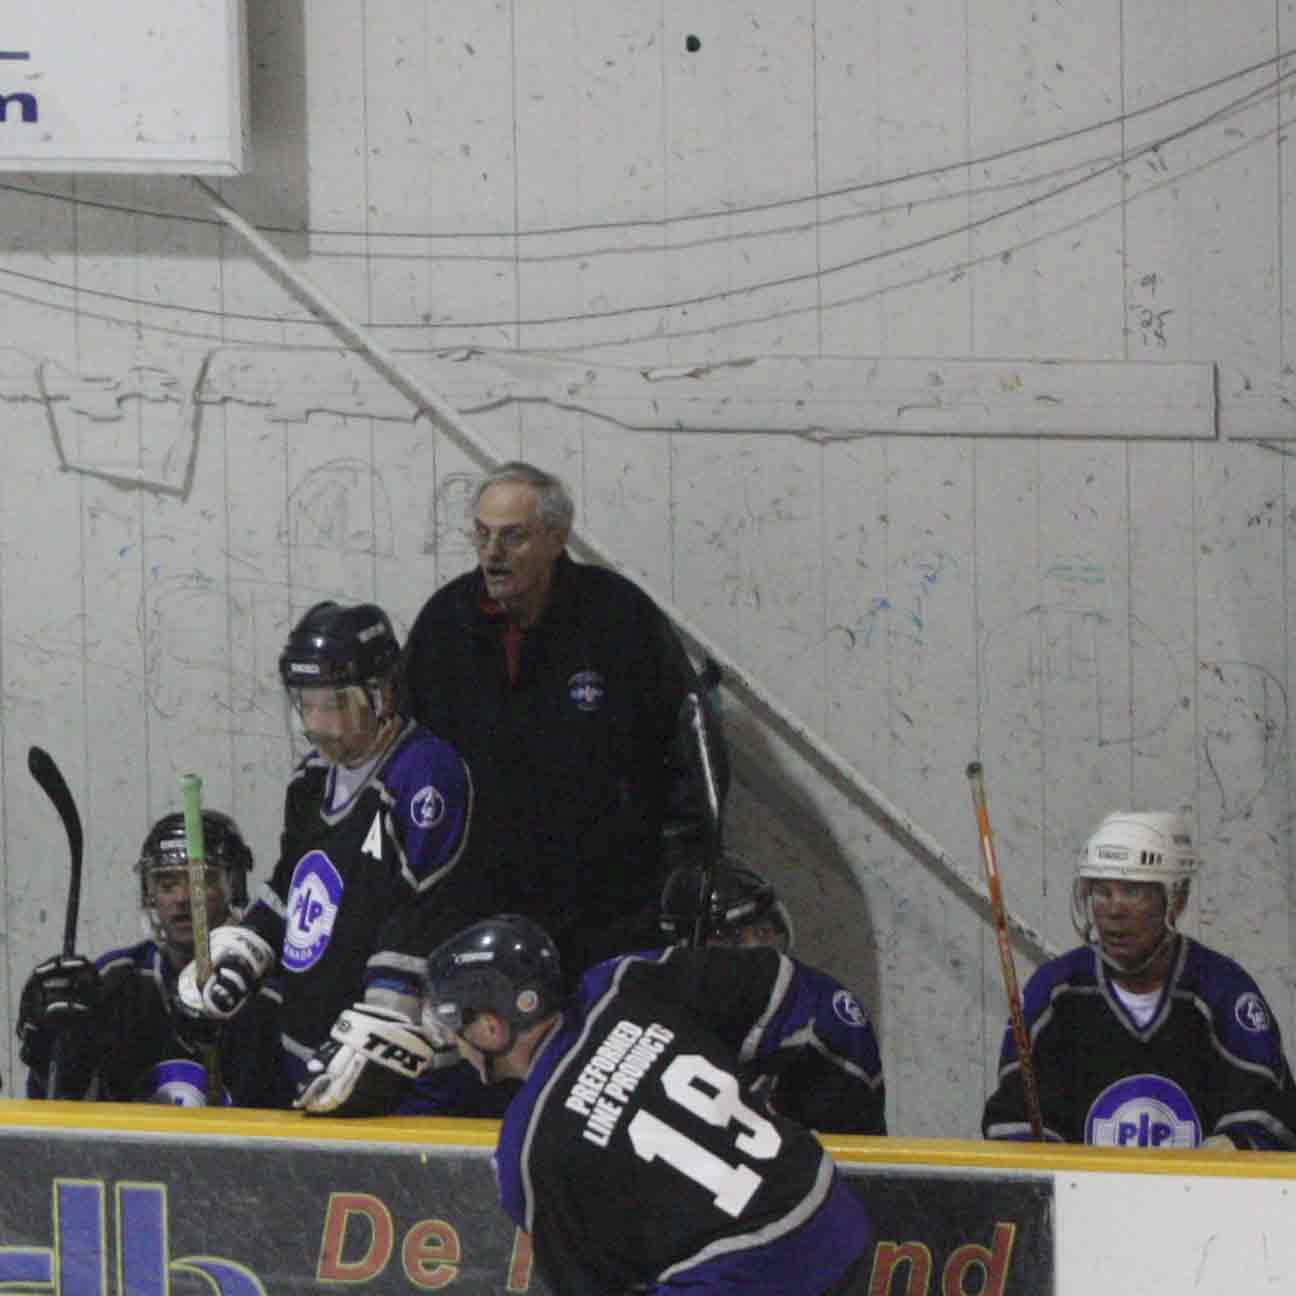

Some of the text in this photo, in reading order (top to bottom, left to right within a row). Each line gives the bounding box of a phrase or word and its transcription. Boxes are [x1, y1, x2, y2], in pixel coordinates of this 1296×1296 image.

[360, 809, 383, 861] A
[582, 1096, 623, 1148] LINE
[628, 1053, 782, 1219] 19
[316, 1191, 461, 1290] De
